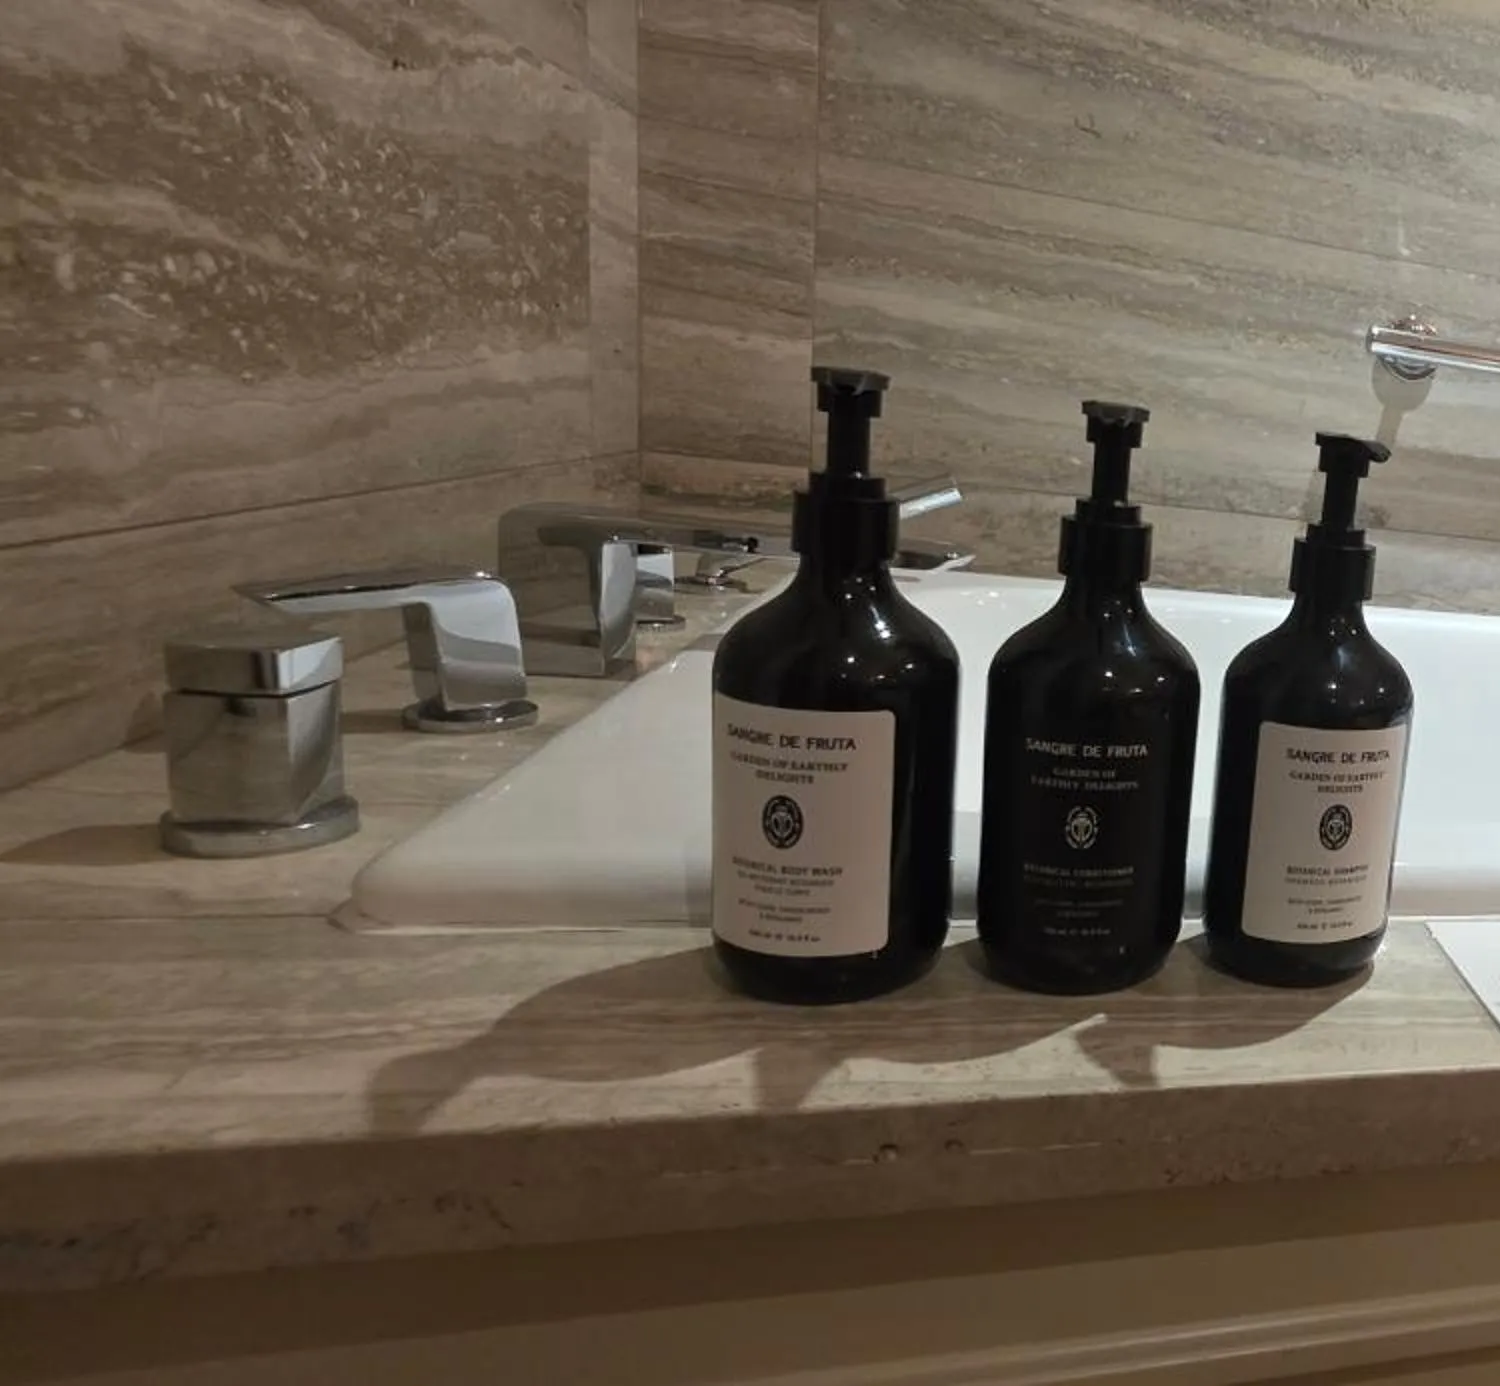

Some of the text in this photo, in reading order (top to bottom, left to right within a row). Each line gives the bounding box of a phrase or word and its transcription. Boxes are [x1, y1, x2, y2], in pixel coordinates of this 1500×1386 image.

[727, 723, 857, 750] SANGRE DE FRUTA
[1025, 737, 1148, 758] SANGRE DE FRUTA
[1286, 748, 1390, 764] SANGRE DE FRUTA
